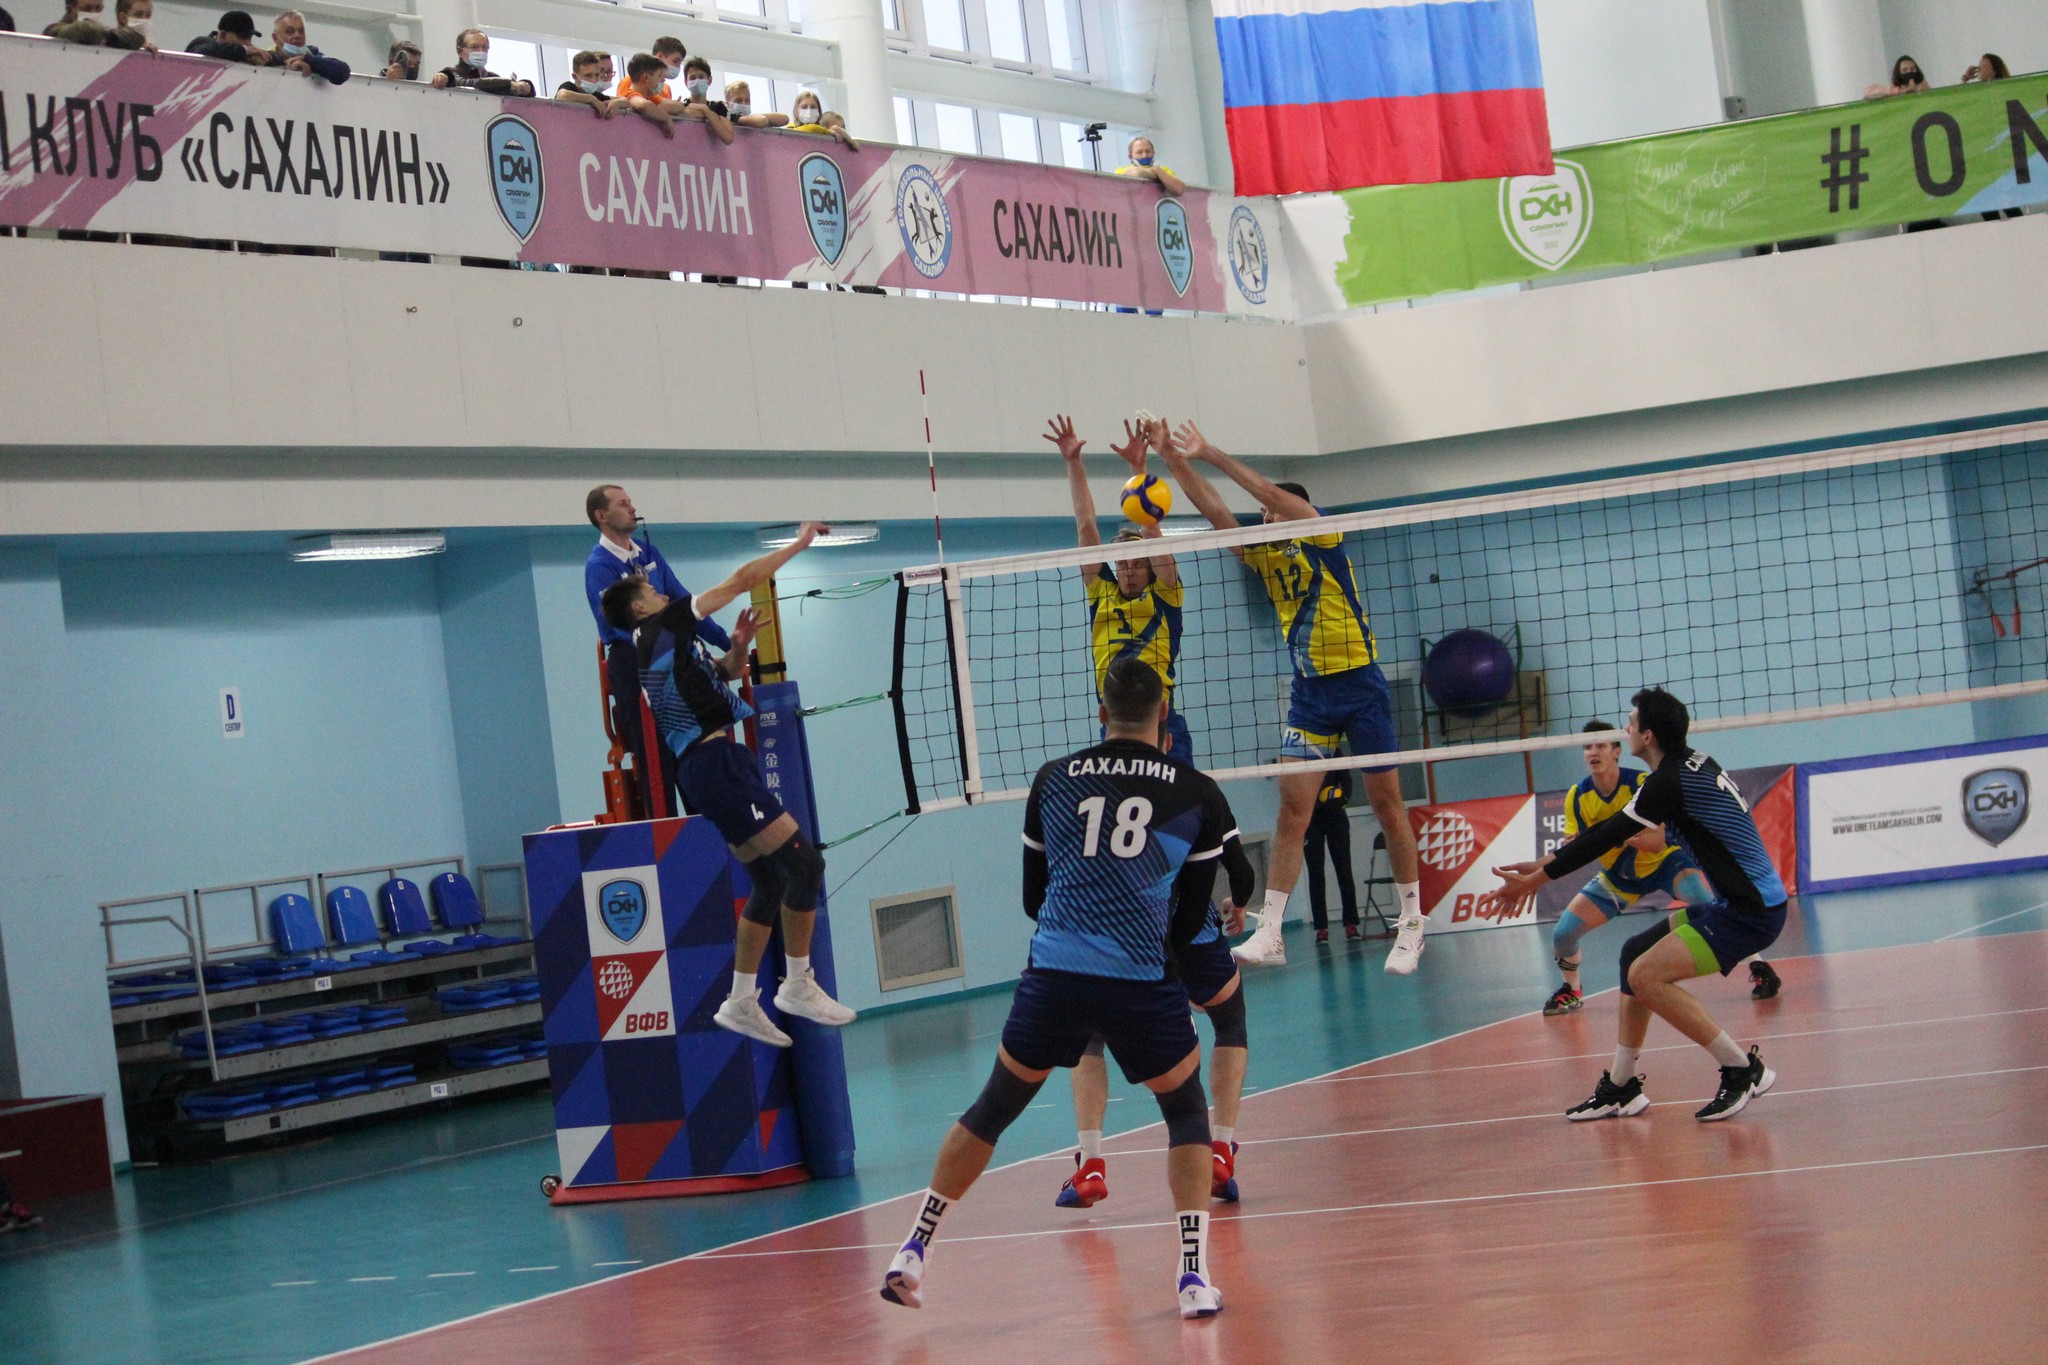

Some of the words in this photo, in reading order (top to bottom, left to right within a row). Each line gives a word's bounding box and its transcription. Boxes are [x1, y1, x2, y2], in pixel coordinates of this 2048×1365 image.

[27, 93, 163, 182] КЛУБ
[181, 111, 450, 206] «САХАЛИН»
[579, 153, 753, 236] САХАЛИН
[993, 199, 1122, 269] САХАЛИН
[1274, 564, 1311, 601] 12
[1113, 608, 1132, 634] 1
[226, 694, 235, 720] D
[1284, 730, 1304, 747] 12
[1068, 757, 1176, 784] САХАЛИН
[1077, 796, 1153, 858] 18
[625, 1011, 668, 1033] ВФВ
[1180, 1215, 1200, 1273] ELITE
